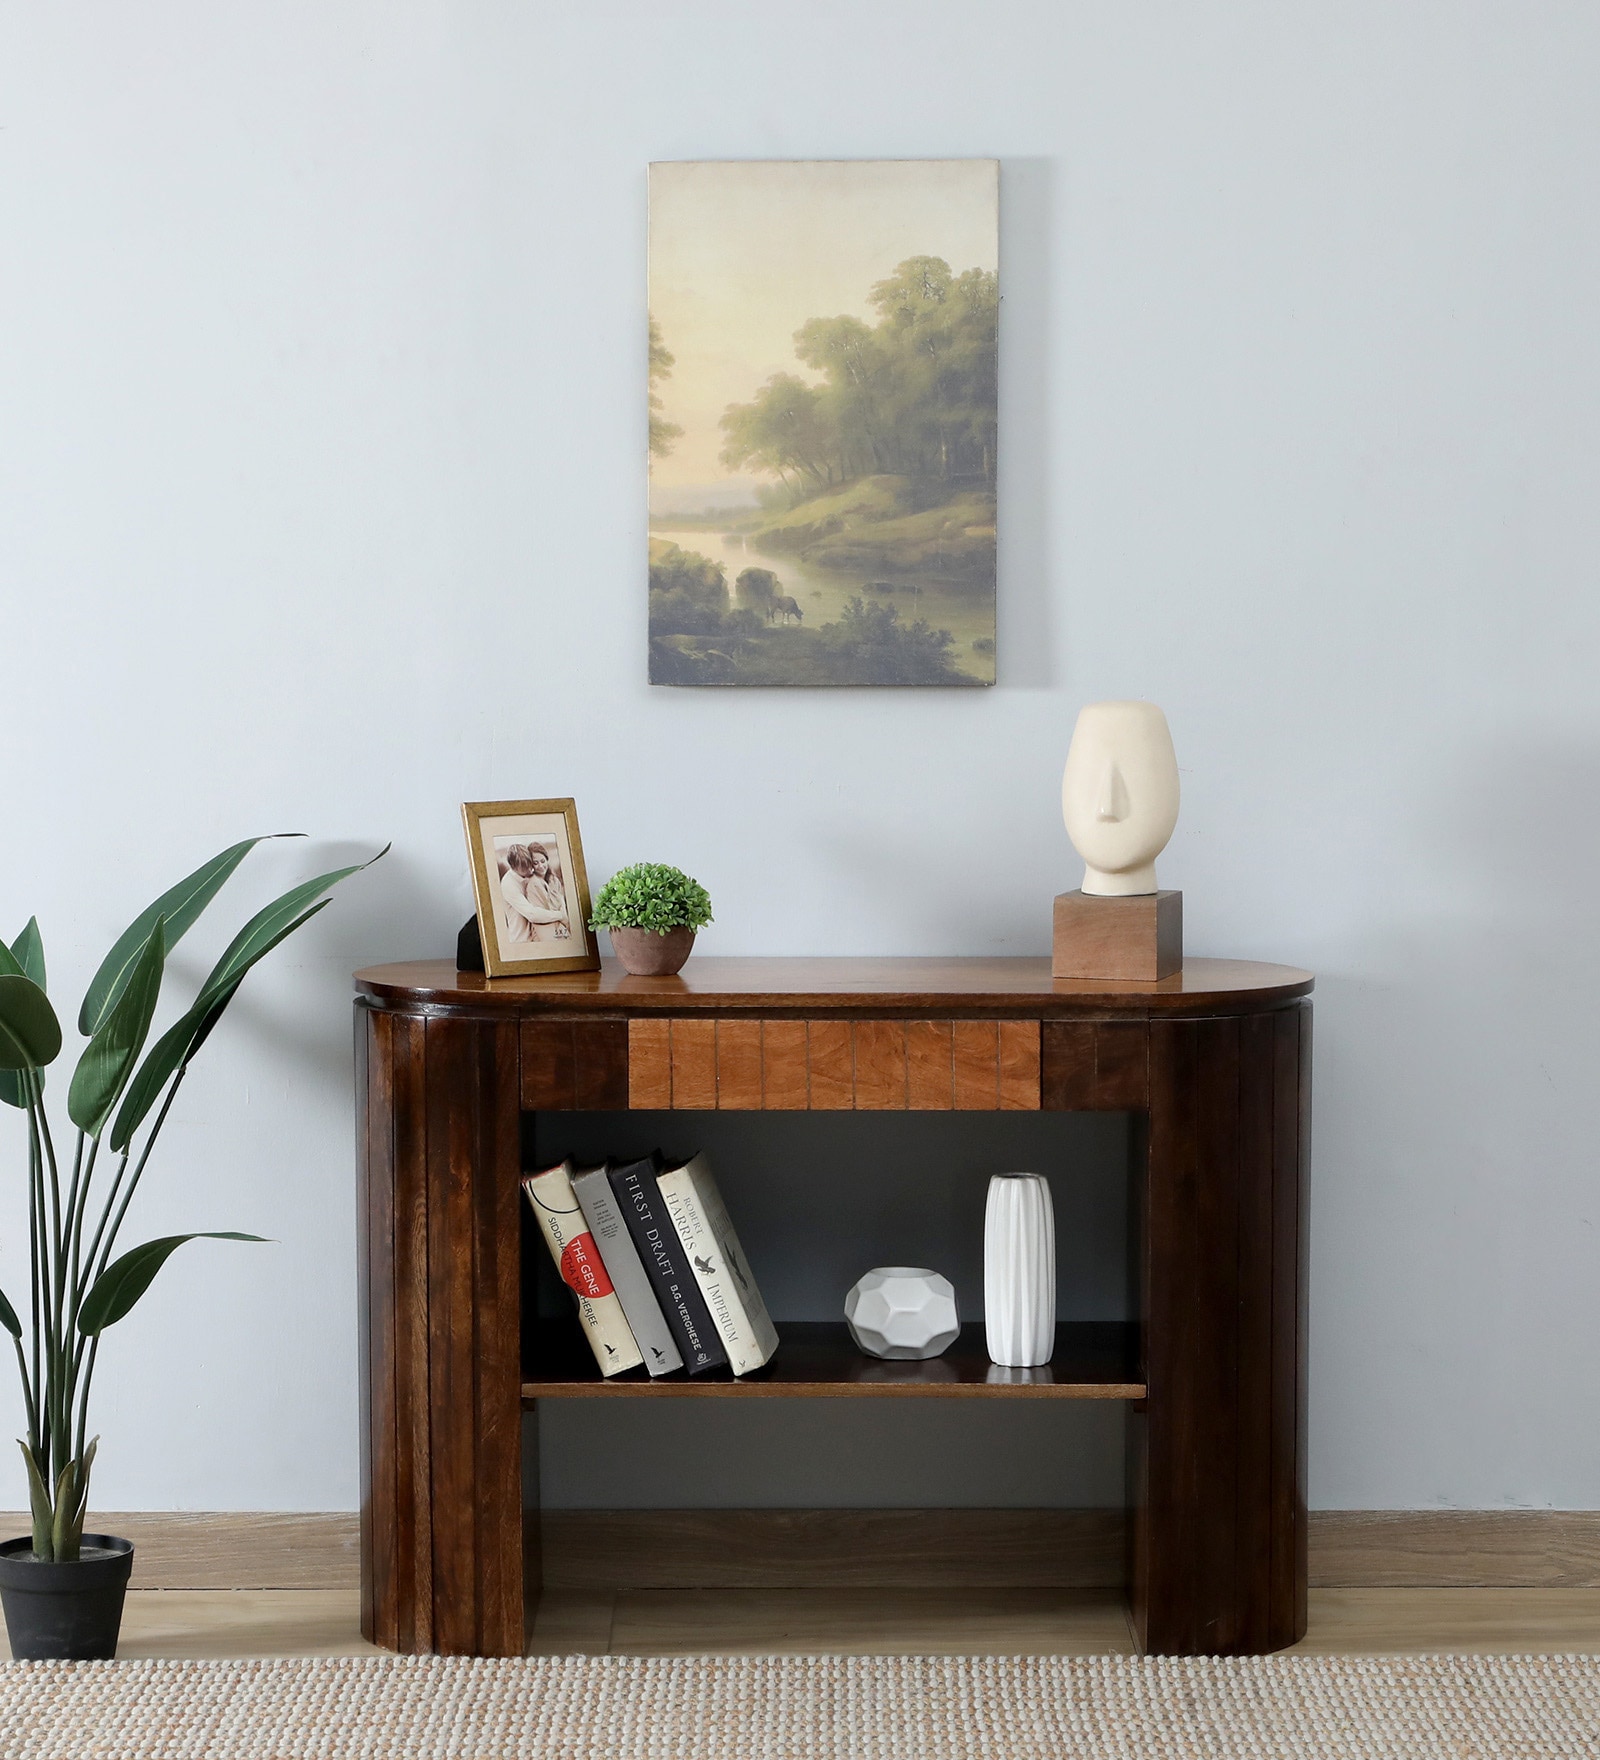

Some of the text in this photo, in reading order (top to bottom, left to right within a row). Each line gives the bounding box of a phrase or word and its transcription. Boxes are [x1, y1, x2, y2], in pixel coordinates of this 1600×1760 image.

[625, 1174, 674, 1276] FIRST DRAFT
[666, 1192, 696, 1250] HARRIS
[684, 1198, 704, 1235] ROBERT
[548, 1217, 598, 1327] SIDDHARTHA MUKHERJEE
[571, 1239, 600, 1295] THE GENE
[670, 1284, 702, 1350] B.G. VERGHESE
[707, 1283, 738, 1343] IMPERIUM
